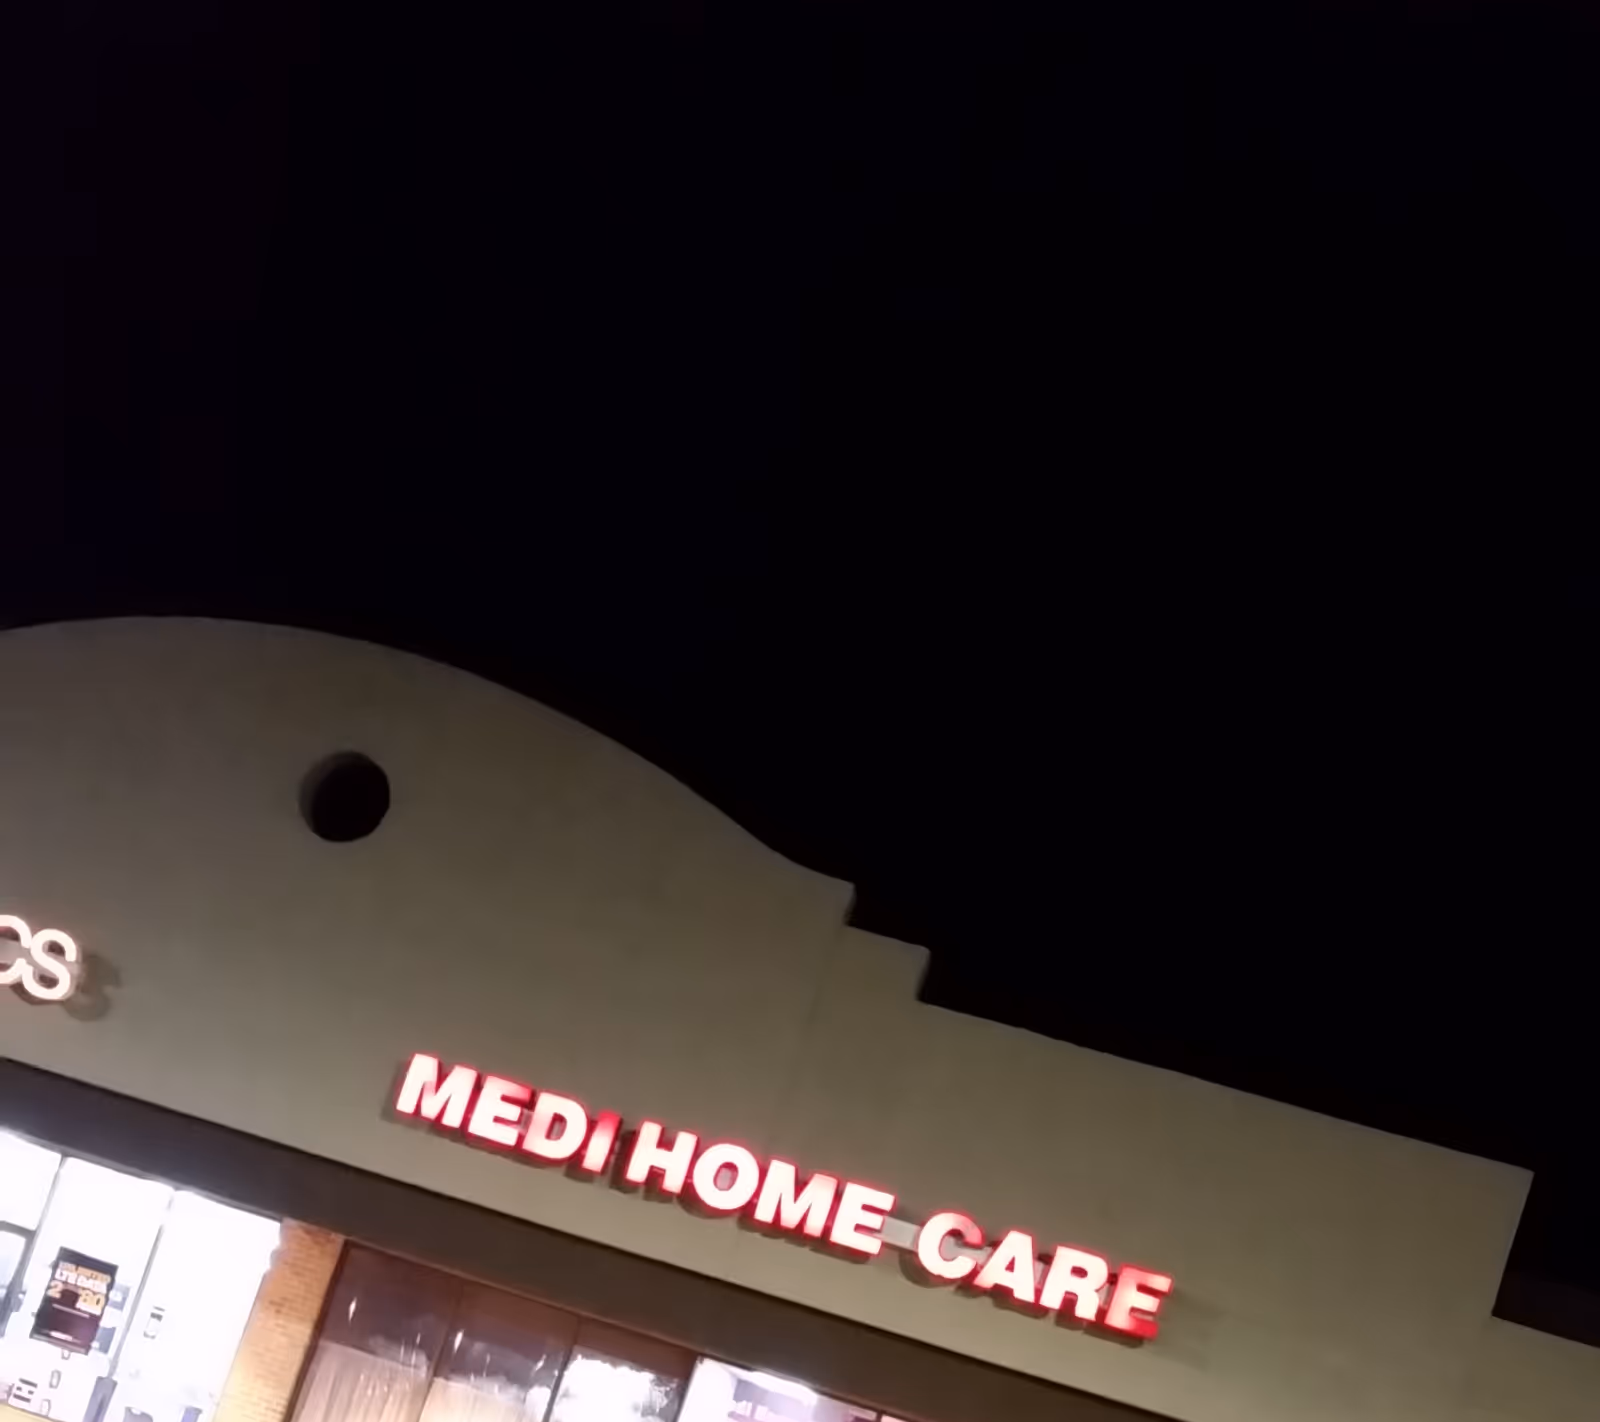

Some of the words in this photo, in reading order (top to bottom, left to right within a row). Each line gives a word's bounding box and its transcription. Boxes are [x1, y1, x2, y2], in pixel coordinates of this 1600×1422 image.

[396, 1053, 621, 1174] MEDI
[626, 1121, 895, 1255] HOME
[917, 1212, 1173, 1340] CARE
